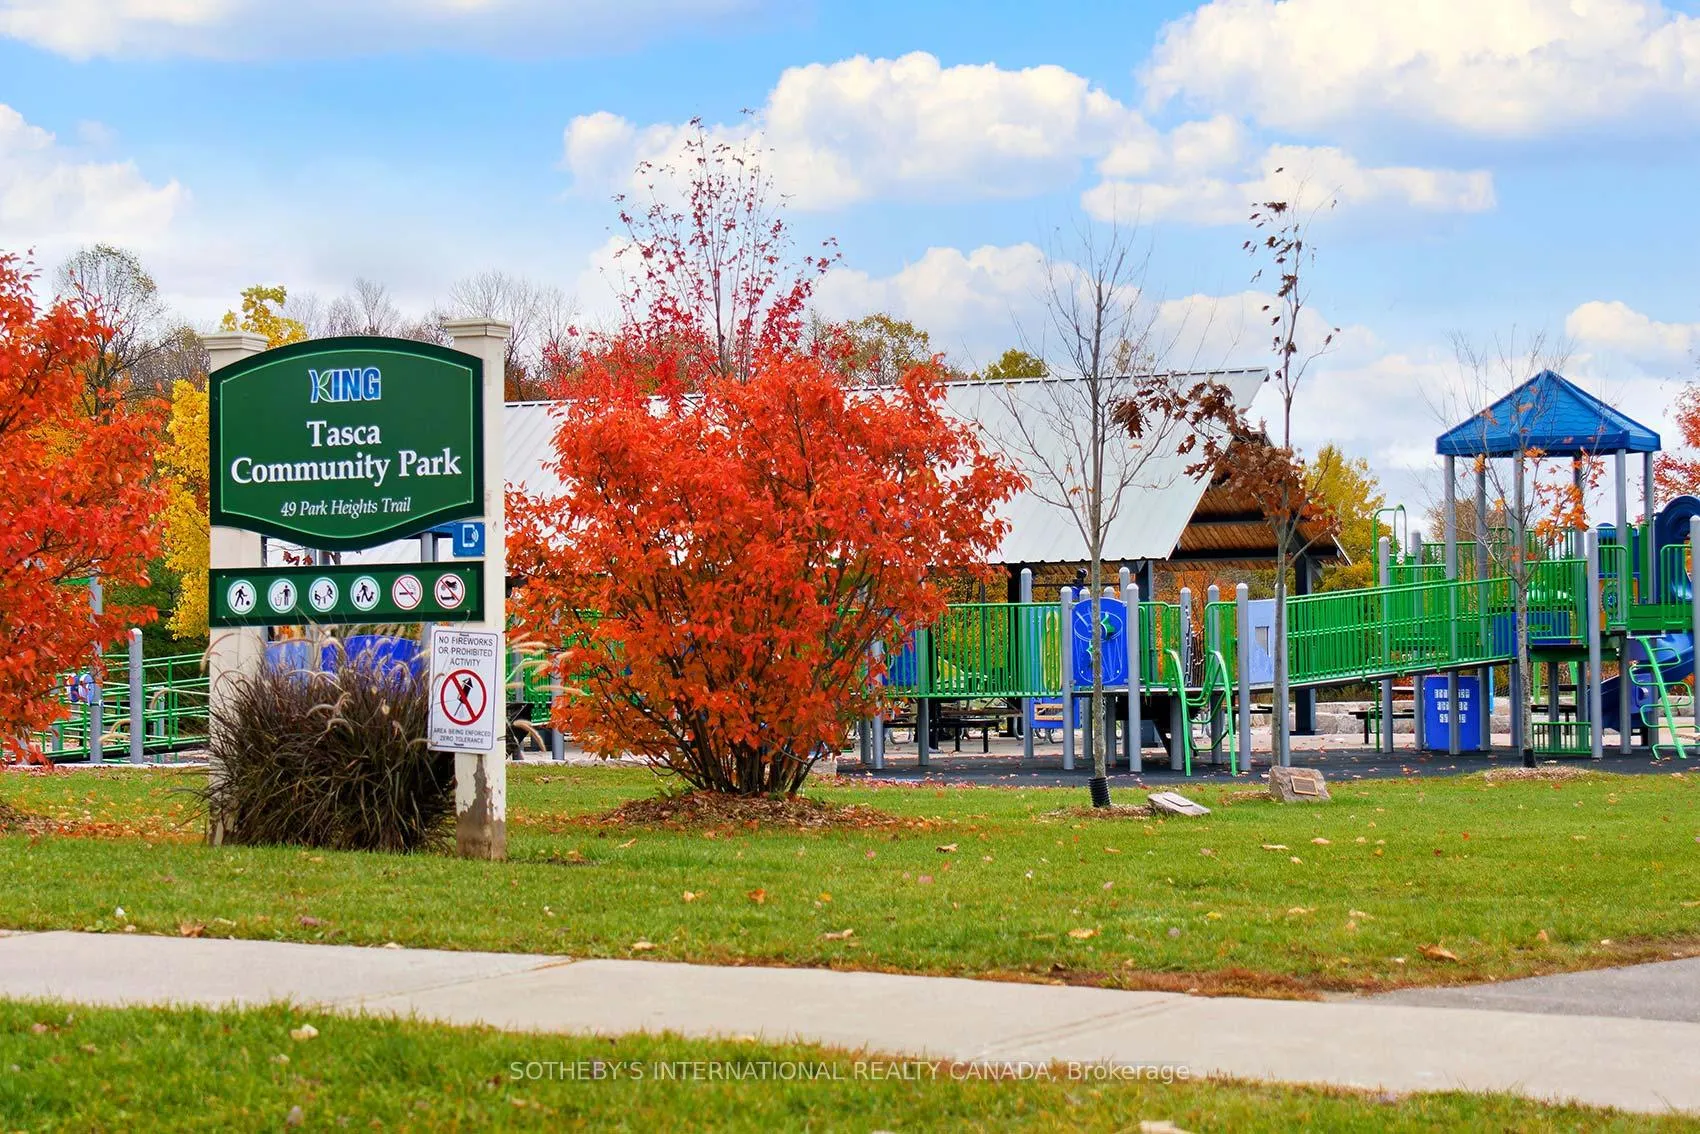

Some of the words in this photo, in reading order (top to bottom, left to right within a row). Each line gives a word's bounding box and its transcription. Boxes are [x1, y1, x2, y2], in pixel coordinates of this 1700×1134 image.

[308, 367, 382, 403] KING
[306, 420, 382, 447] Tasca
[231, 451, 391, 487] Community
[398, 447, 462, 477] Park
[280, 501, 297, 517] 49
[300, 500, 328, 516] Park
[331, 499, 378, 519] Heights
[381, 497, 411, 513] Trail
[438, 636, 449, 644] NO
[451, 637, 493, 647] FIREWORKS
[438, 646, 449, 655] OR
[451, 647, 493, 657] PROHIBITED
[450, 658, 481, 667] ACTIVITY
[455, 736, 484, 744] TOLERANCE
